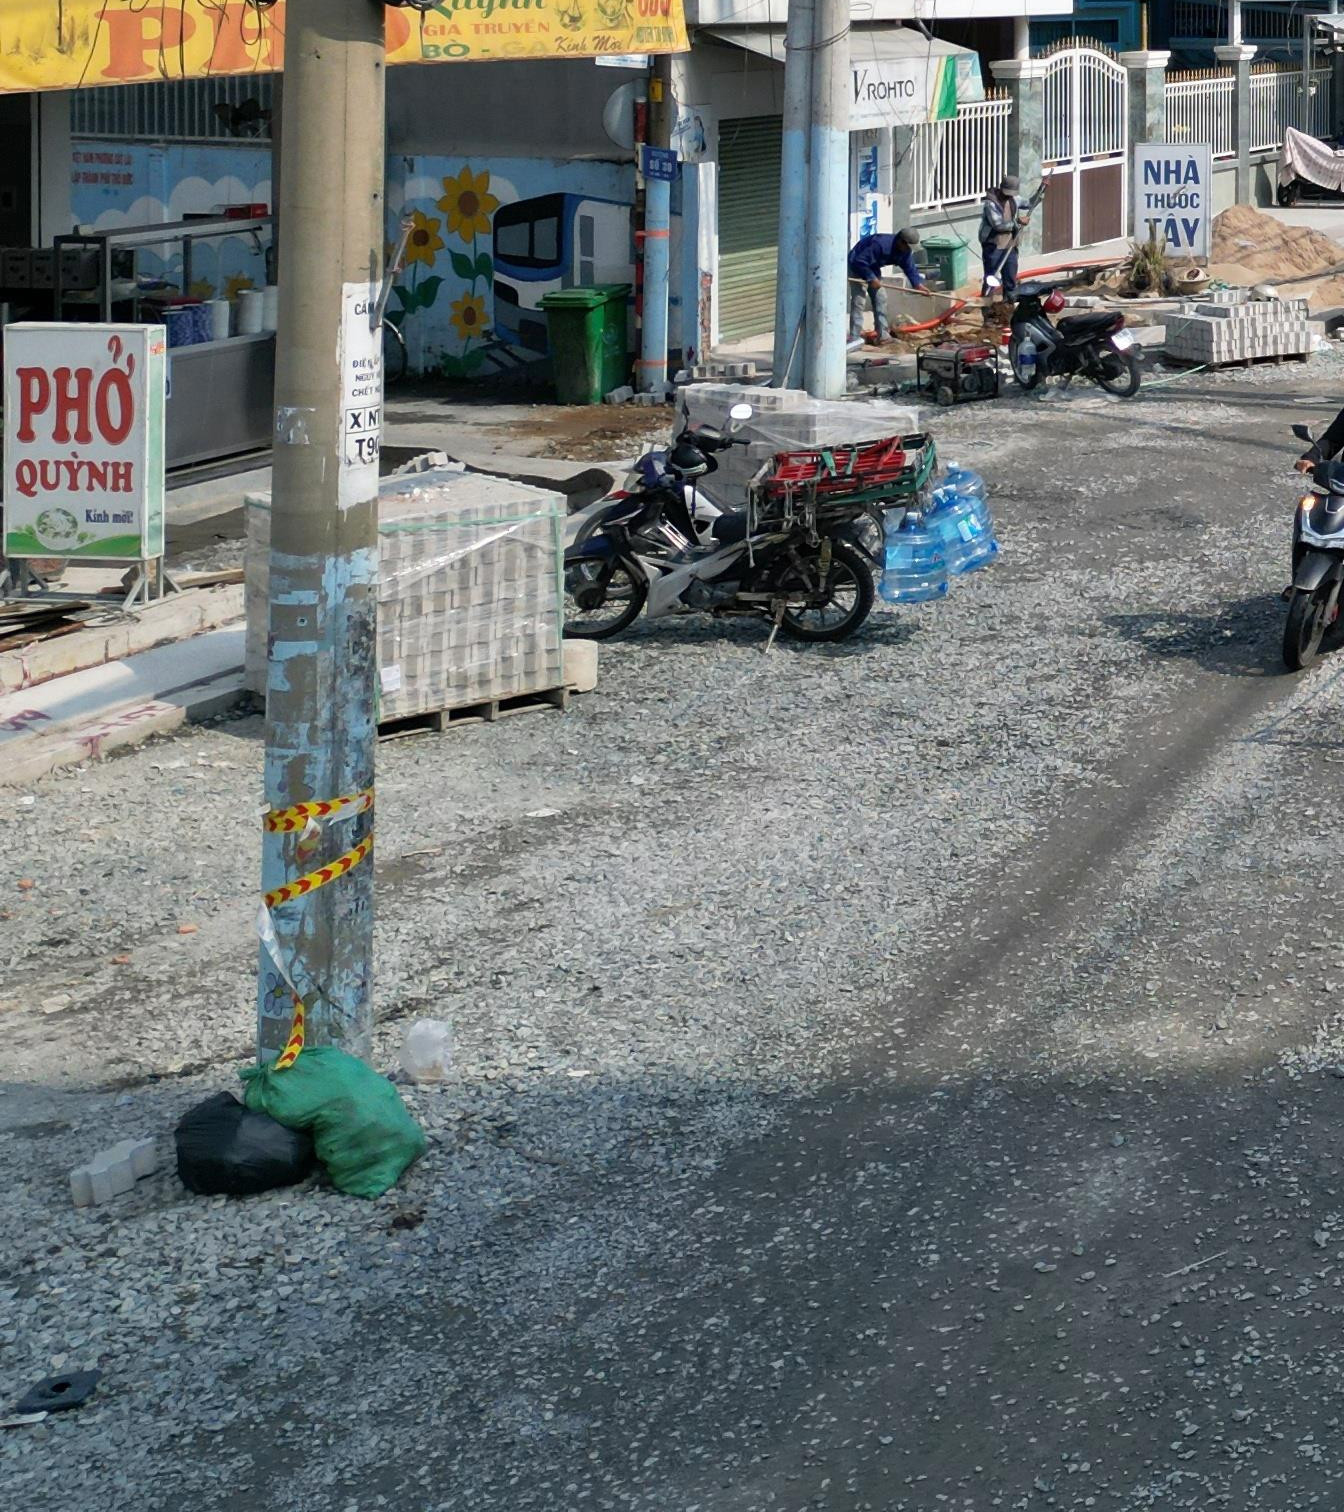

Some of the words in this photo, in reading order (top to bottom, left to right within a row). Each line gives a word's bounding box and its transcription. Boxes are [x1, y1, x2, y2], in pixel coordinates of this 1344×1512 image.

[423, 23, 462, 36] GIA
[422, 39, 470, 58] BÒ
[852, 68, 915, 104] V.ROHTO
[1144, 154, 1200, 185] NHÀ
[1144, 213, 1200, 248] TÂY
[16, 335, 135, 445] PHỞ
[350, 412, 362, 429] X
[16, 451, 134, 498] QUỲNH
